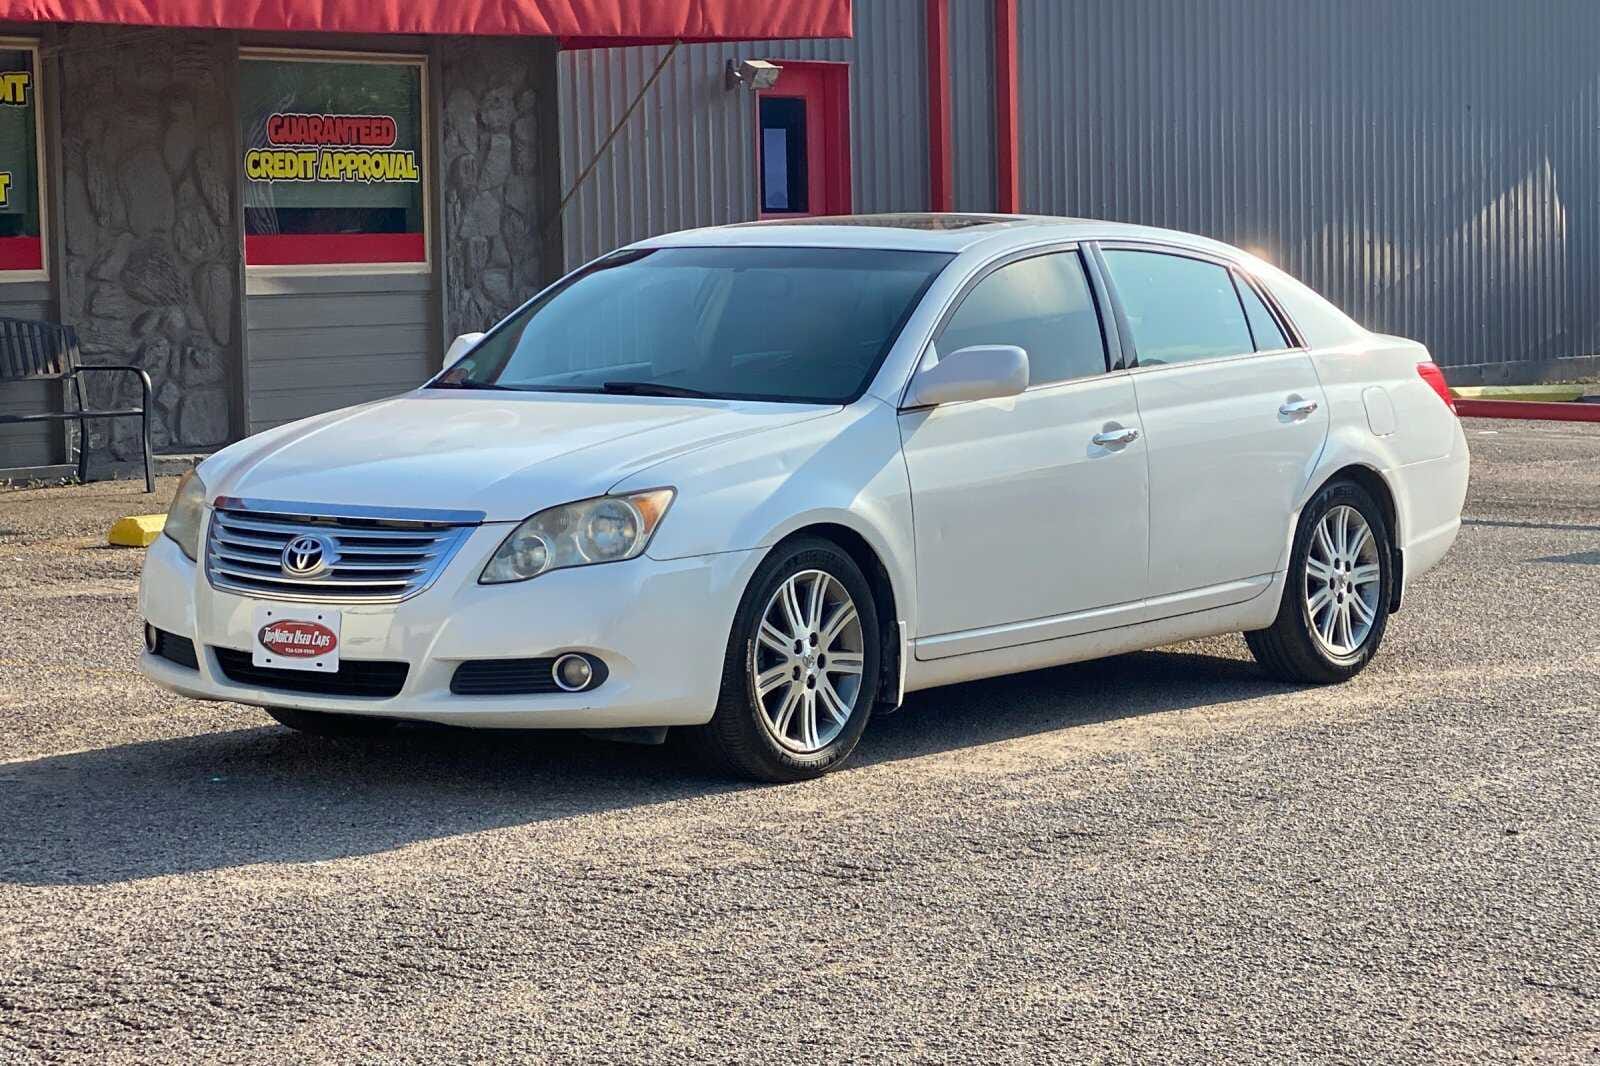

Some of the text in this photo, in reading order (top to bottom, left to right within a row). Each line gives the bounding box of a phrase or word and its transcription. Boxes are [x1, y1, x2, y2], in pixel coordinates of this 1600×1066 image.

[268, 114, 396, 147] GUARANTEED
[246, 150, 418, 182] CREDIT APPROVAL
